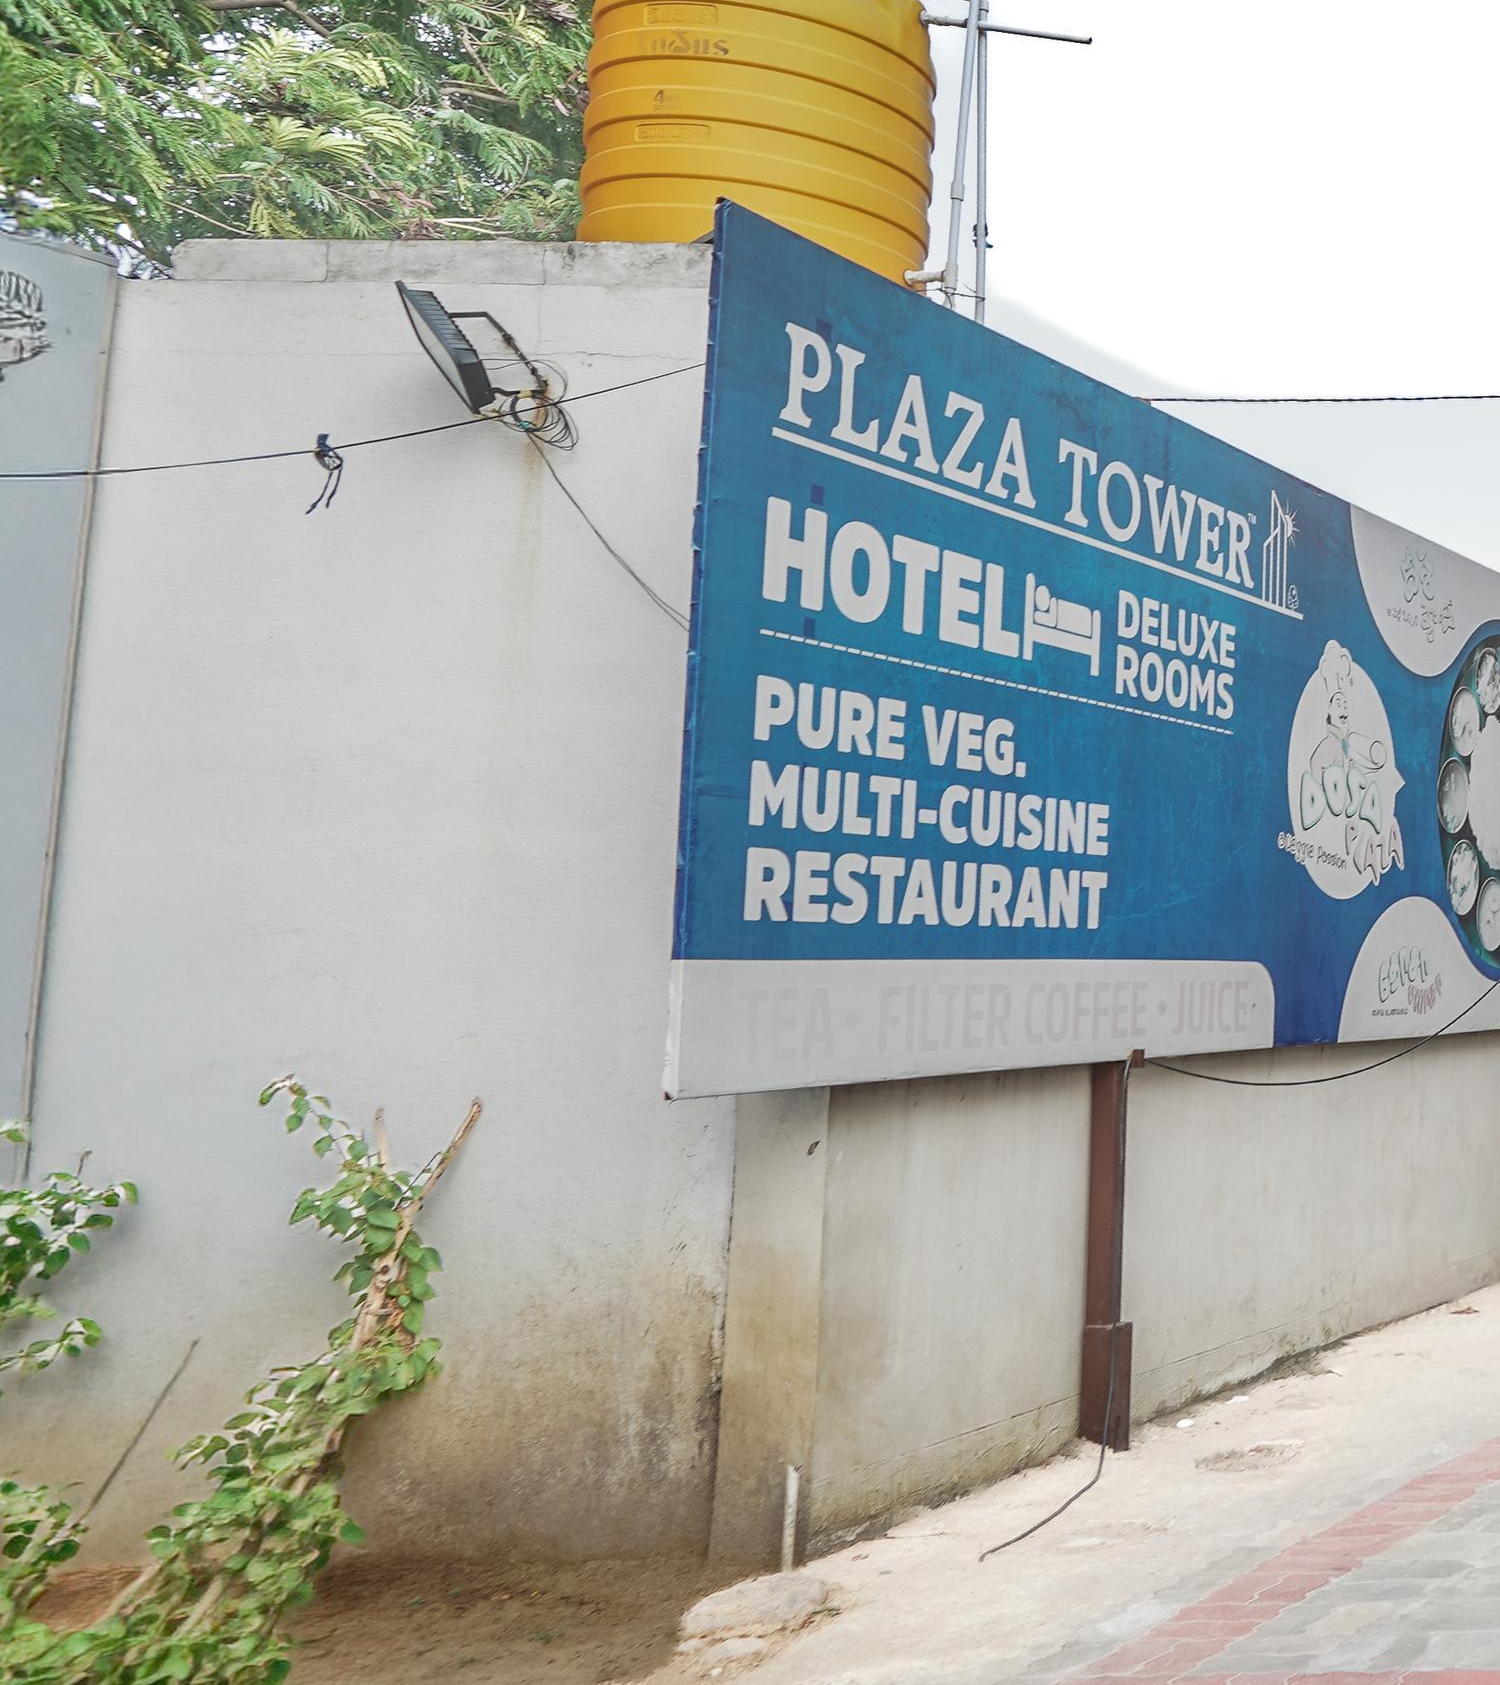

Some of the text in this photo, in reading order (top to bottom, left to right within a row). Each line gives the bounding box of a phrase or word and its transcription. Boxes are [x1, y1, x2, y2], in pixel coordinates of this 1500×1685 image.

[778, 321, 1037, 509] PLAZA
[1058, 437, 1255, 588] TOWER
[762, 496, 1020, 659] HOTEL
[1117, 589, 1237, 669] DELUXE
[1114, 643, 1235, 720] ROOMS
[753, 674, 1028, 779] PURE VEG.
[748, 759, 1110, 857] MULTI-CUISINE
[1300, 764, 1383, 835] DOSA
[743, 846, 1109, 931] RESTAURANT
[739, 980, 1249, 1065] TEA FILTER COFFEE JUICE
